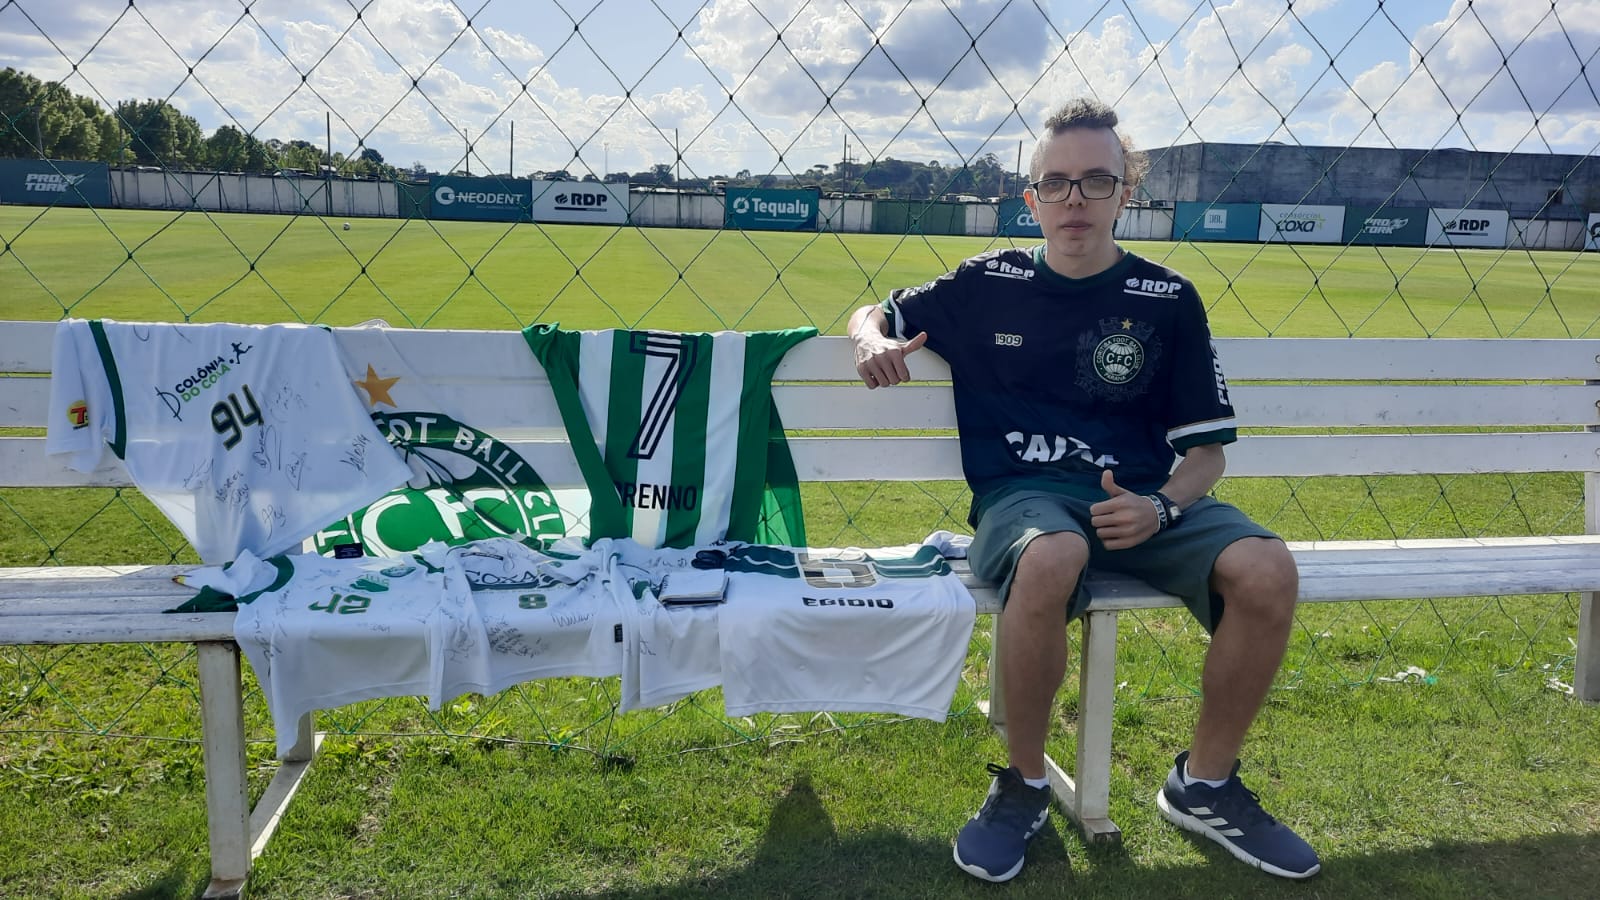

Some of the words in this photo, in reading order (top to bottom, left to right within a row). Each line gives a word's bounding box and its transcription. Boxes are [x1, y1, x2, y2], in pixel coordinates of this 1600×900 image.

[26, 173, 61, 183] PRO
[25, 183, 69, 192] TORK
[458, 191, 524, 204] NEODENT
[571, 193, 608, 206] RDP
[752, 197, 809, 218] Tequaly
[1459, 219, 1490, 231] RDP
[1000, 261, 1035, 279] RDP
[1141, 279, 1182, 294] RDP
[995, 333, 1023, 347] 1909
[175, 355, 225, 394] COLÔNIA
[181, 386, 201, 402] DO
[626, 331, 699, 460] 7
[211, 385, 265, 451] 94
[452, 426, 526, 485] BALL
